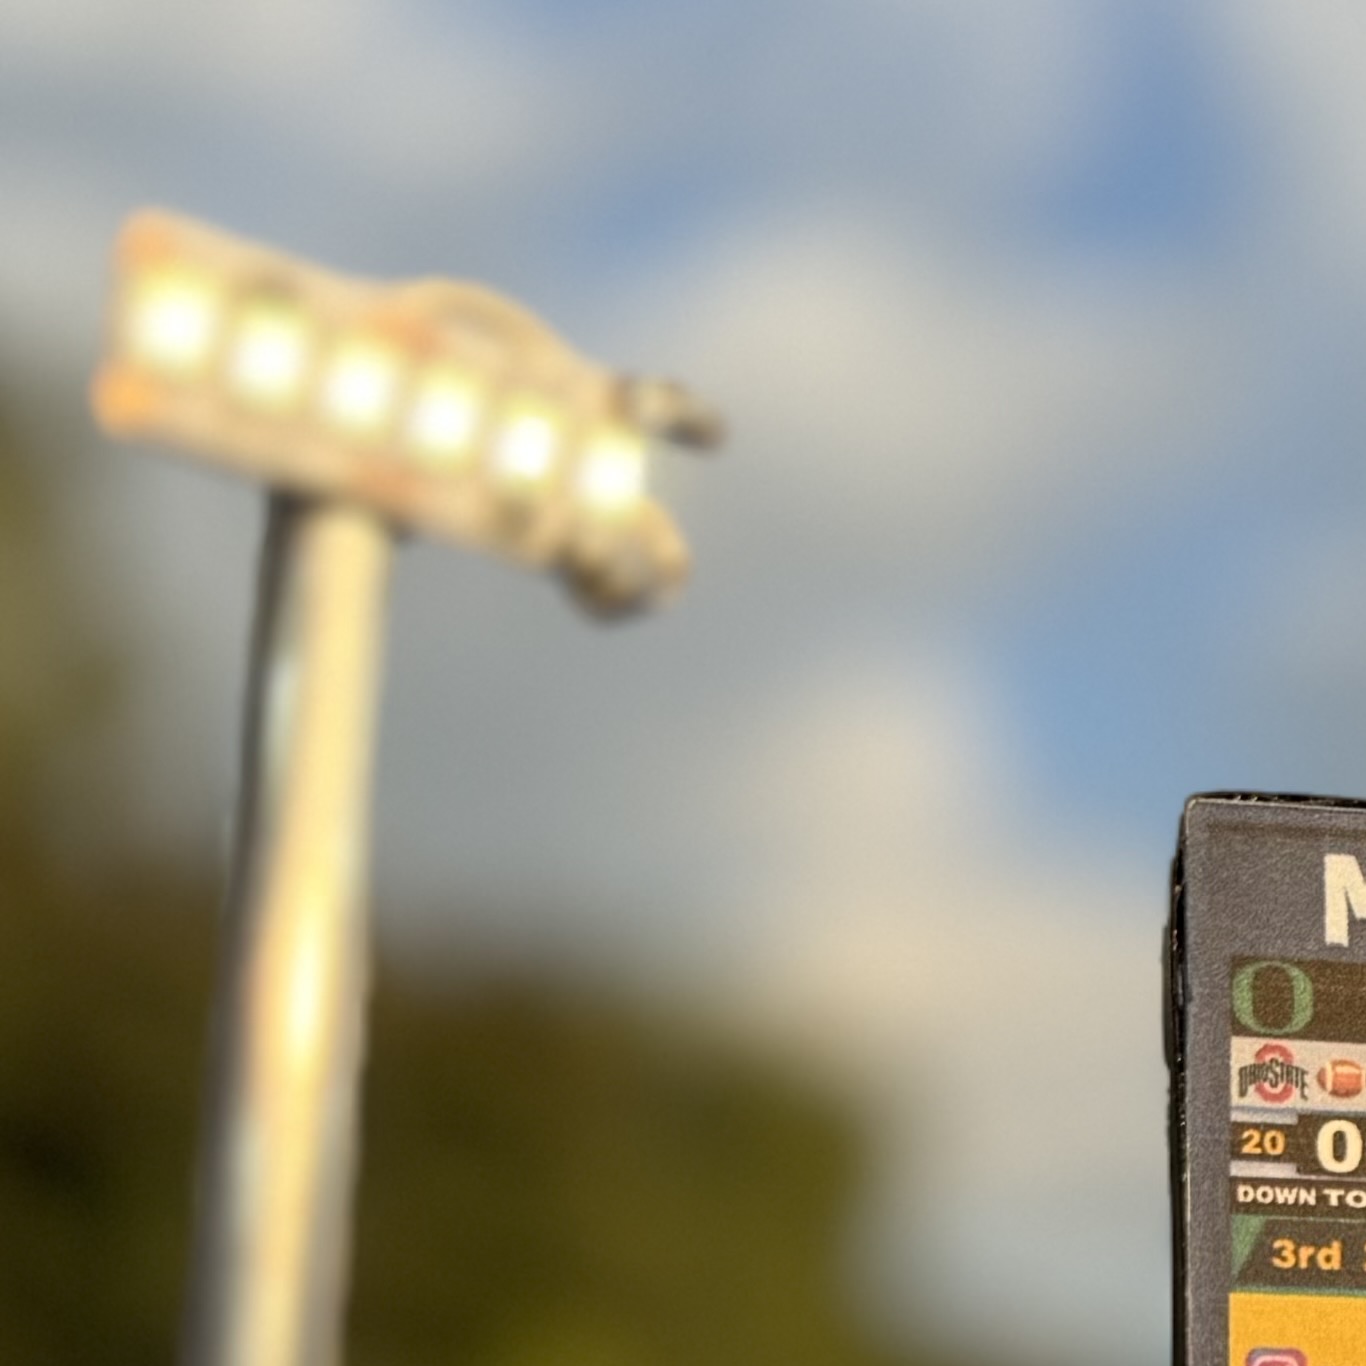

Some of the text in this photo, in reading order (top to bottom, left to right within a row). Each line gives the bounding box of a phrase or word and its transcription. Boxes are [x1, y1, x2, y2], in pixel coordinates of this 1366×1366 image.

[1241, 1129, 1286, 1155] 20
[1237, 1184, 1316, 1206] DOWN
[1271, 1238, 1343, 1271] 3rd
